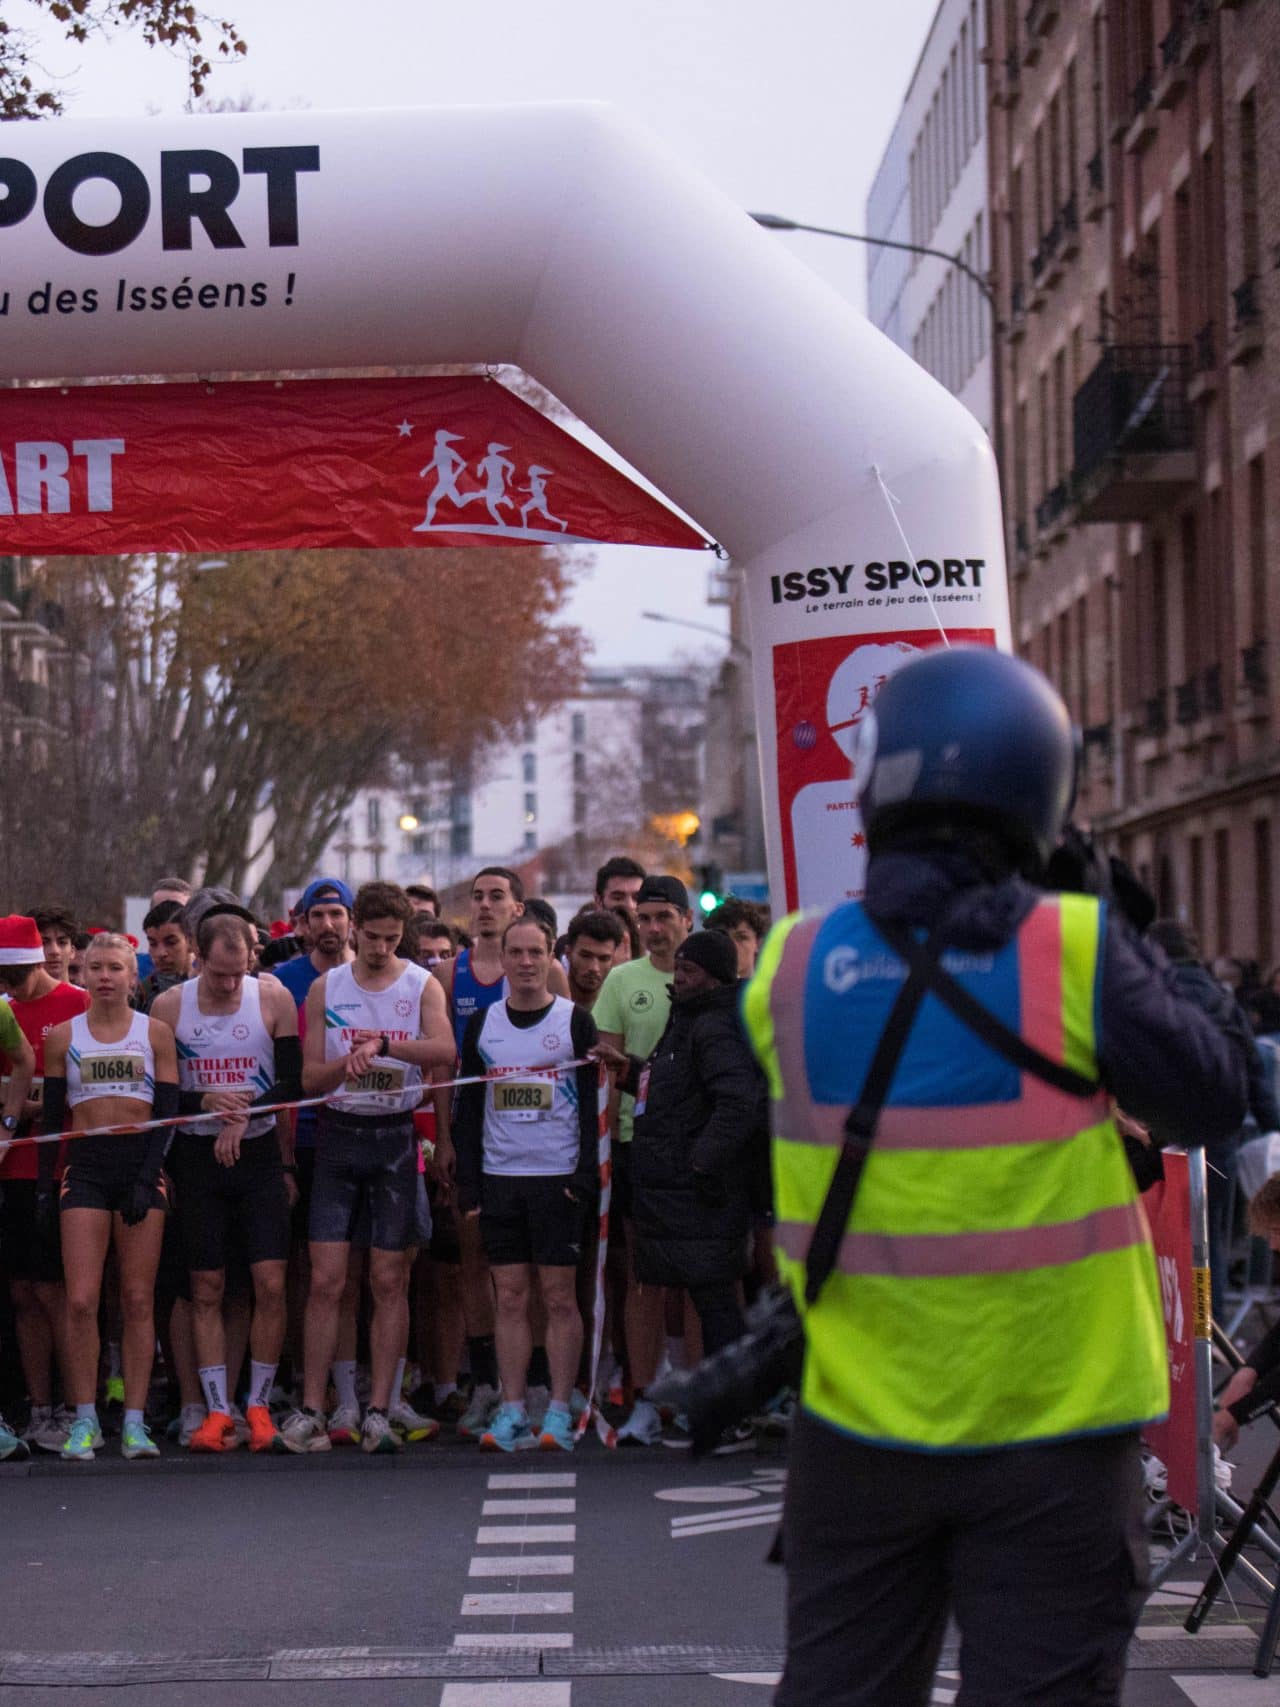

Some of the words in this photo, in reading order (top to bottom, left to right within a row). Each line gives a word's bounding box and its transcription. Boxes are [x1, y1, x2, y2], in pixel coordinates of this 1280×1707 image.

[26, 279, 101, 317] des
[116, 276, 268, 313] Isséens
[282, 272, 297, 306] !
[771, 564, 854, 604] ISSY
[864, 559, 985, 591] SPORT
[805, 603, 820, 614] Le
[822, 597, 864, 611] terrain
[867, 596, 883, 607] de
[885, 595, 905, 608] jeu
[908, 594, 928, 604] des
[91, 1060, 134, 1080] 10684
[186, 1056, 257, 1072] ATHLETIC
[198, 1071, 246, 1085] CLUBS
[502, 1087, 543, 1107] 10283
